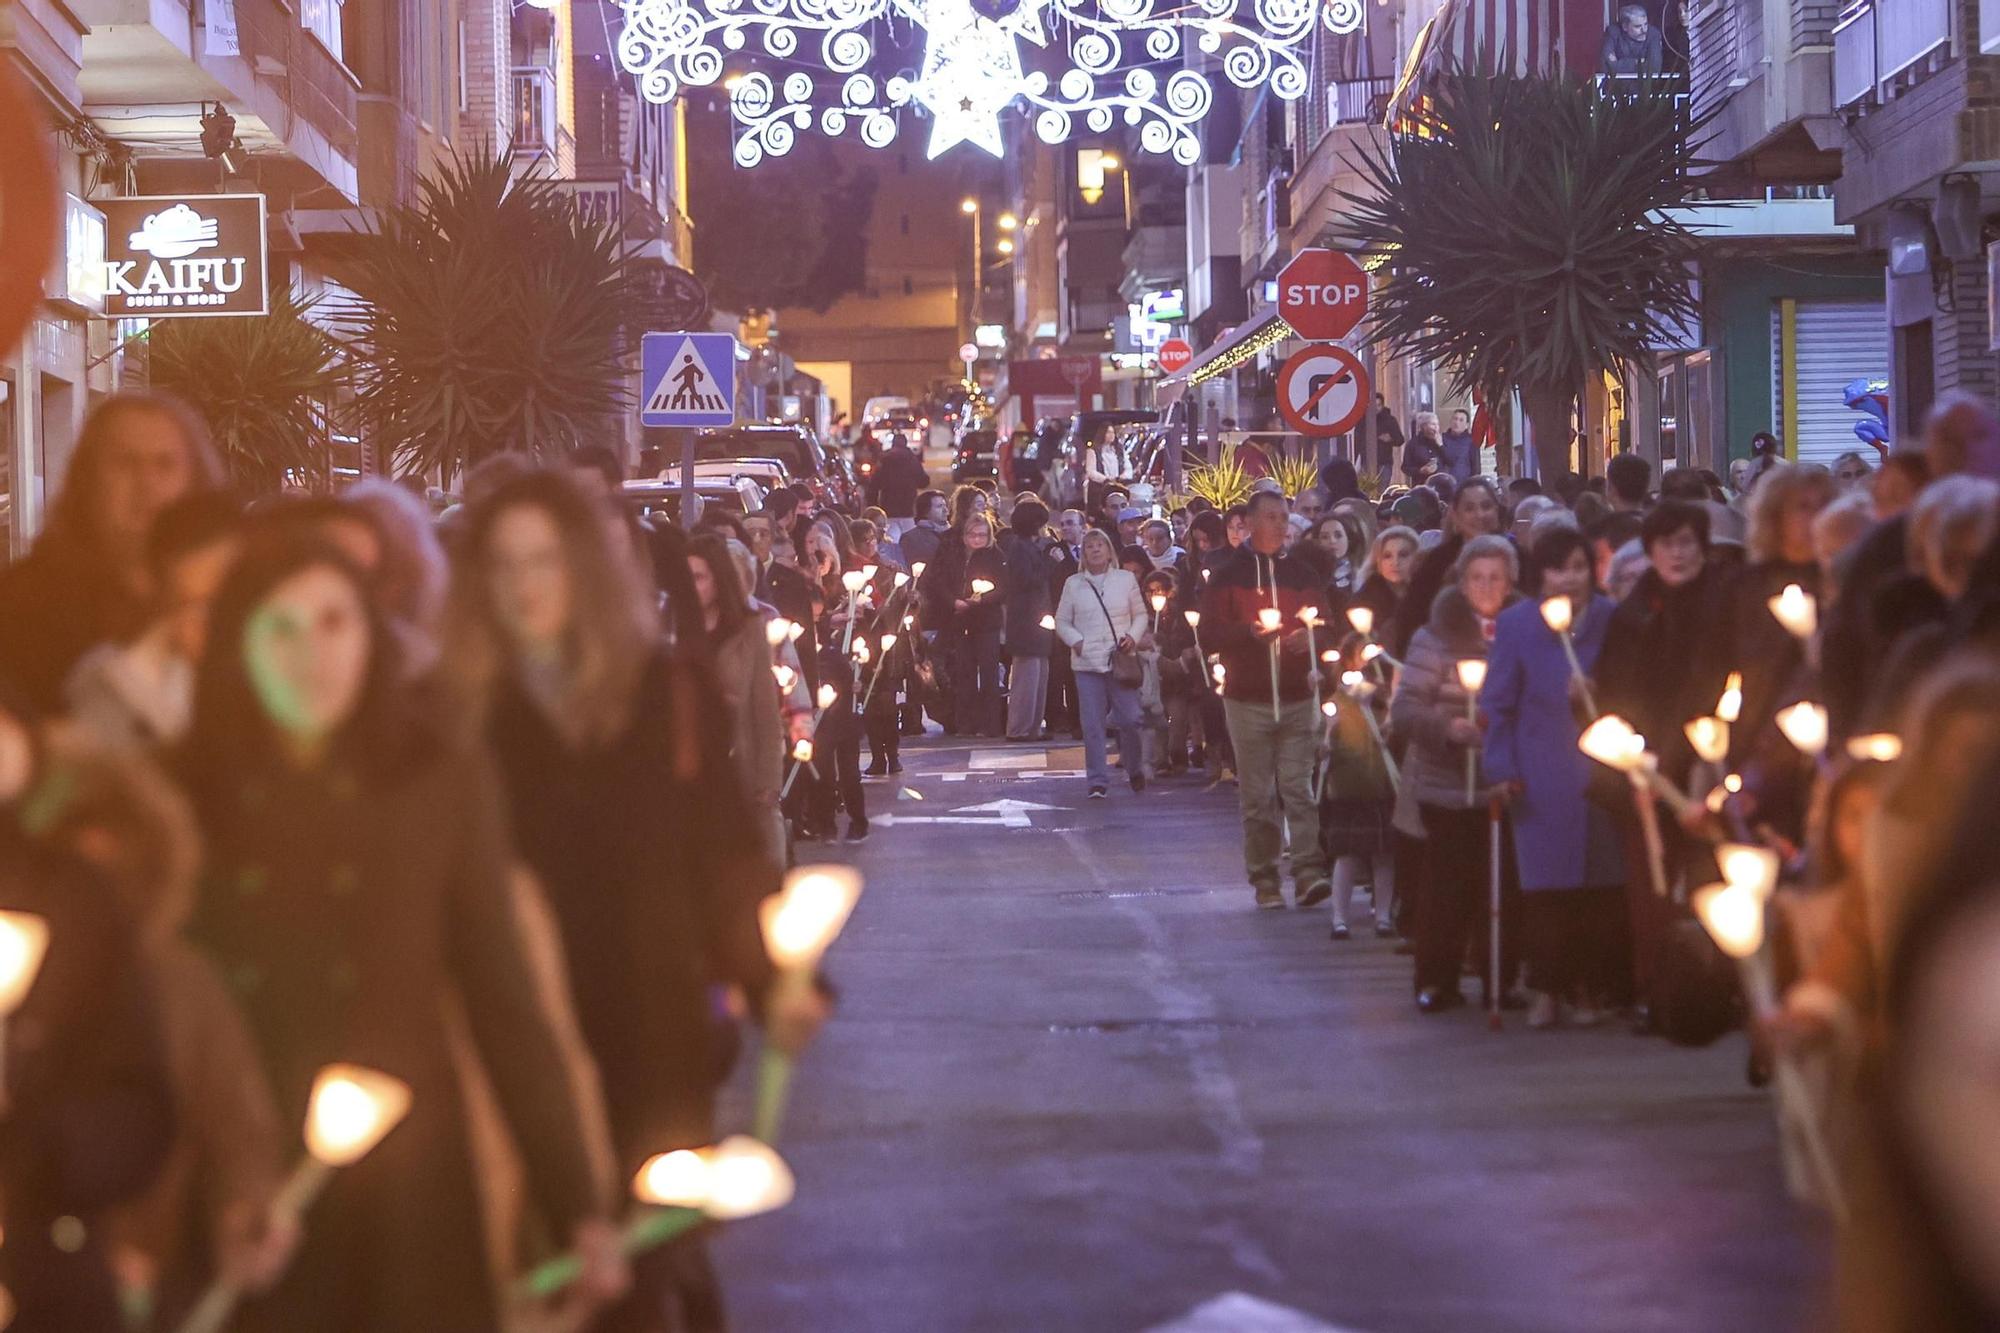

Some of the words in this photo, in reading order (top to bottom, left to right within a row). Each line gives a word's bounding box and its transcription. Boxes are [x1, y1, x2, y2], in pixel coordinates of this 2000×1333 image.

[103, 257, 246, 295] KAIFU
[1286, 284, 1360, 305] STOP
[1161, 351, 1190, 361] STOP
